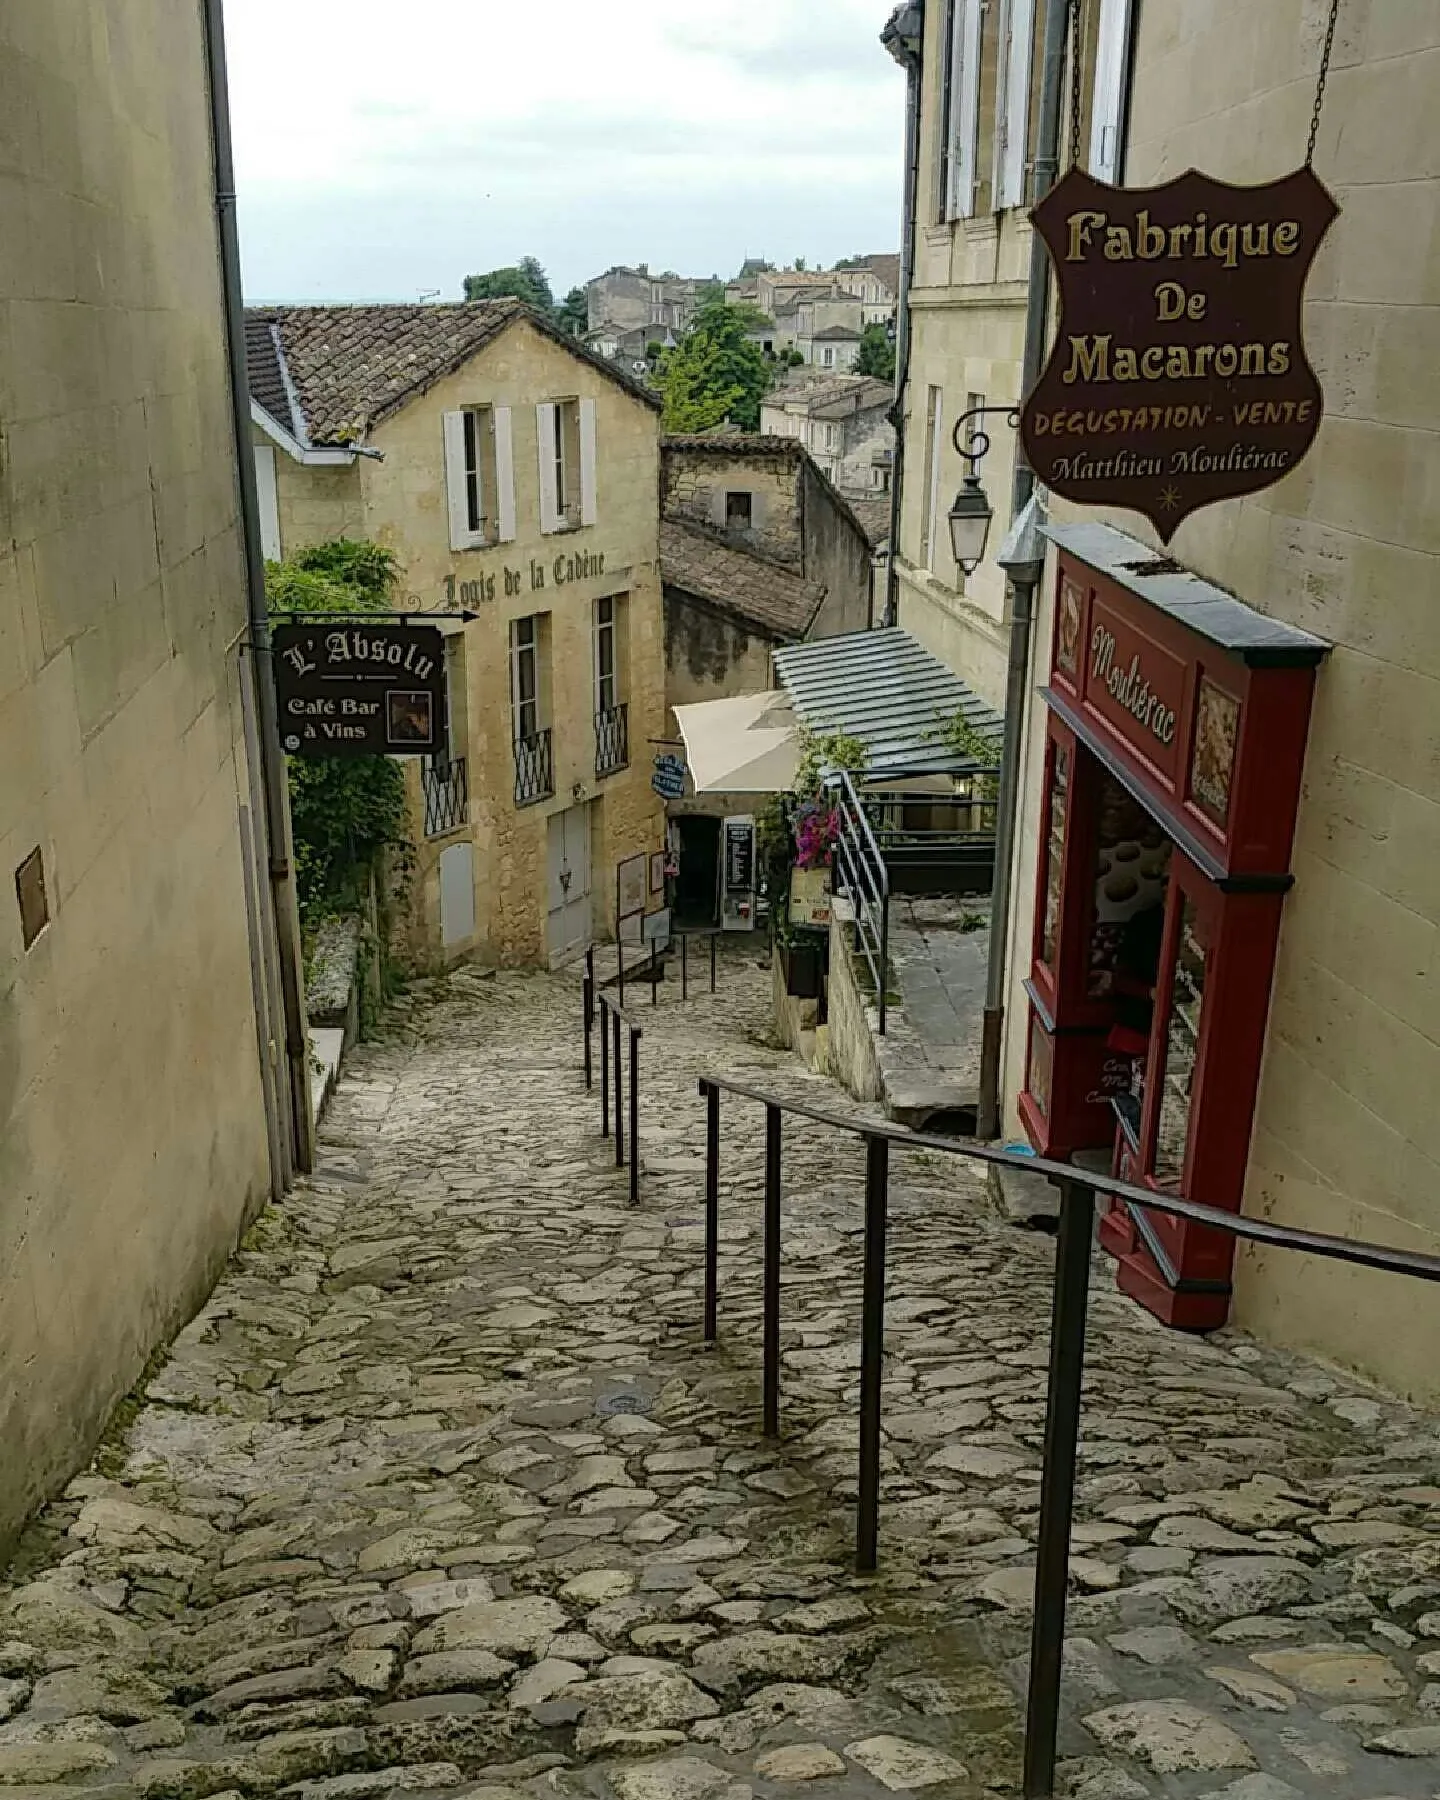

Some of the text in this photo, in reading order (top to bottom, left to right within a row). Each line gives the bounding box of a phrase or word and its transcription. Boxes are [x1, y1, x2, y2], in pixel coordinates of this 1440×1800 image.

[1064, 209, 1300, 268] Fabrique
[1154, 282, 1206, 321] De
[1062, 334, 1290, 384] Macarons
[1232, 399, 1314, 425] VENTE
[1049, 443, 1289, 482] Matthieu Mouliérac
[530, 558, 545, 591] la
[1091, 624, 1175, 743] Mouliérac
[287, 698, 380, 715] Café Bar
[321, 722, 368, 739] Vins
